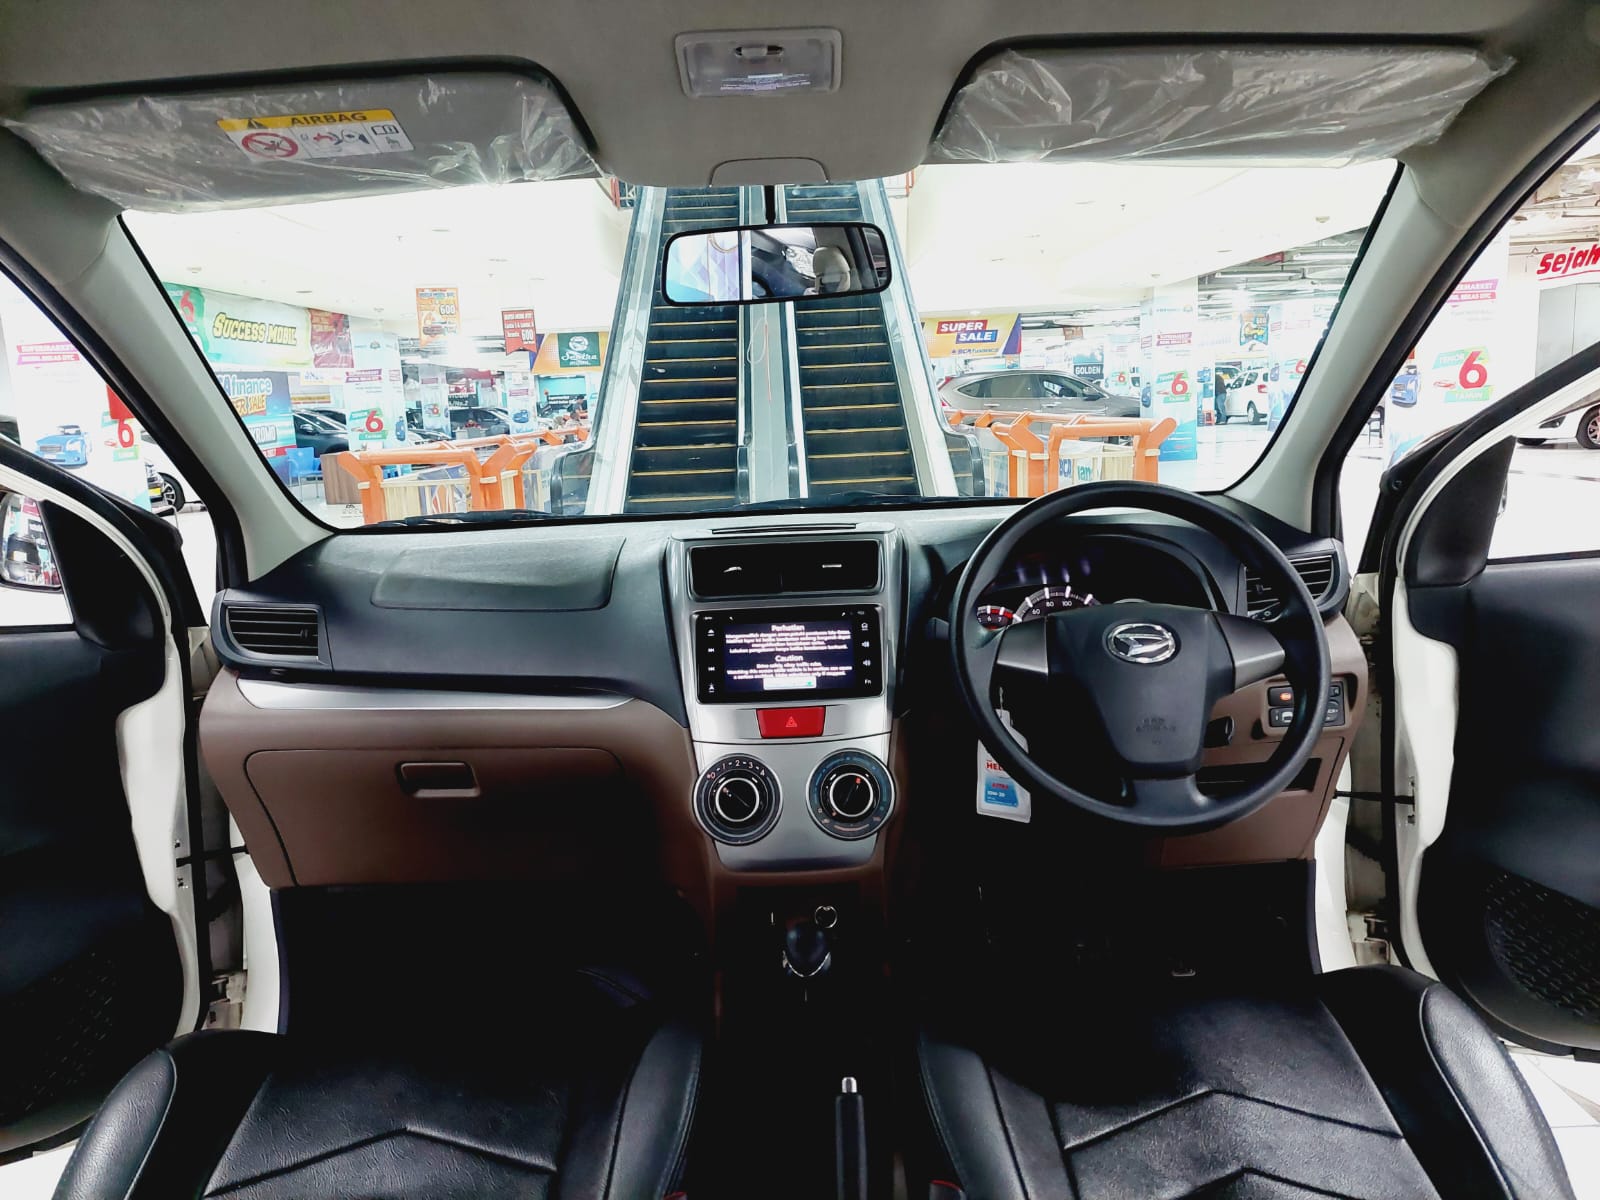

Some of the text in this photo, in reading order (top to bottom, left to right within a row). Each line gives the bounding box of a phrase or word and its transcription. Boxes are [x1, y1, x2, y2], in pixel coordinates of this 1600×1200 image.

[291, 112, 368, 126] AIRBAG
[180, 290, 195, 323] 6
[940, 322, 983, 332] SUPER
[958, 332, 993, 341] SALE
[1075, 366, 1101, 375] GOLDEN
[1458, 350, 1488, 390] 6
[1171, 372, 1188, 395] 6
[365, 410, 384, 433] 6
[735, 759, 741, 767] 2
[748, 761, 754, 769] 3
[760, 768, 766, 776] 4
